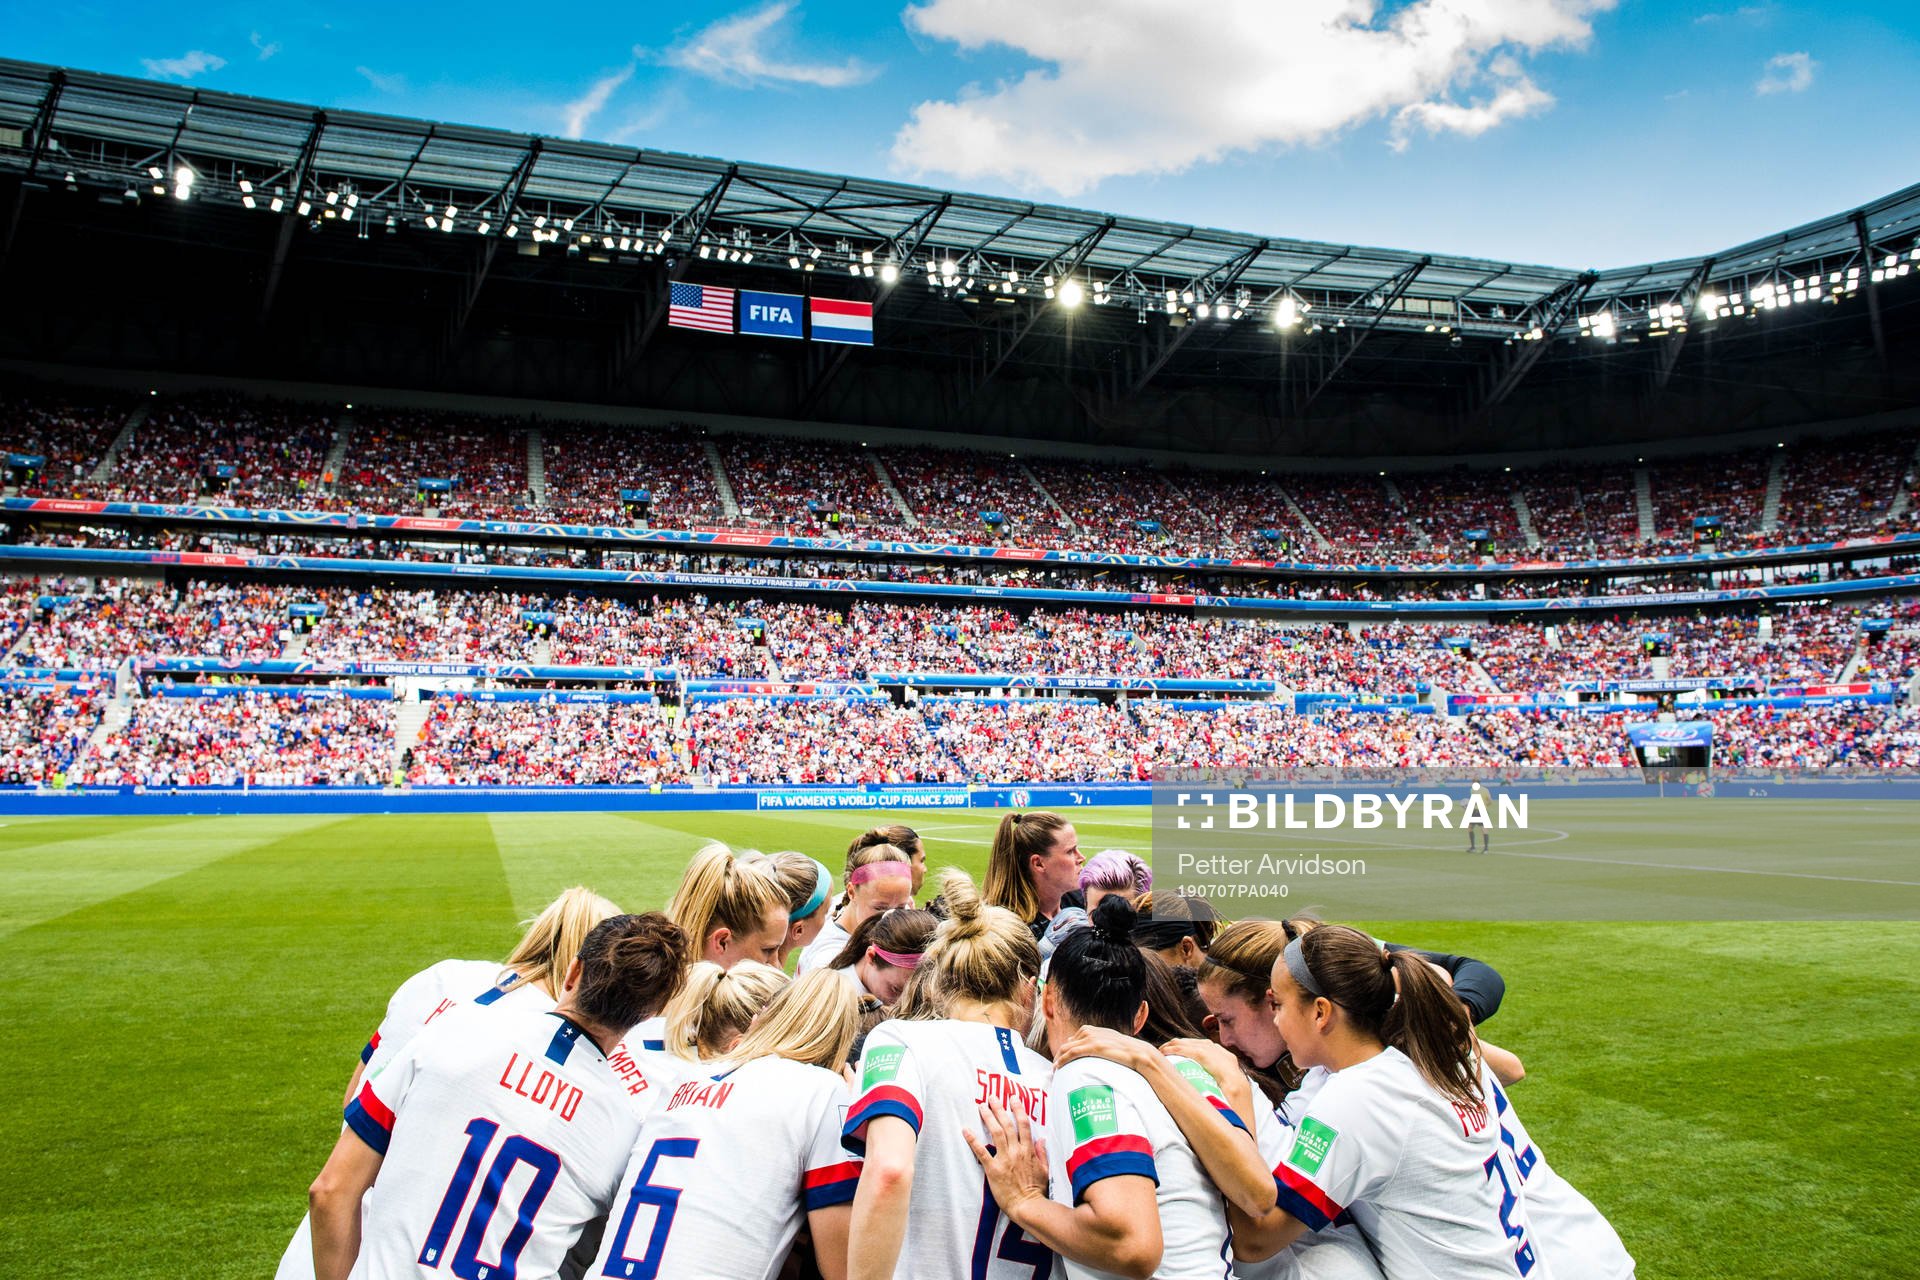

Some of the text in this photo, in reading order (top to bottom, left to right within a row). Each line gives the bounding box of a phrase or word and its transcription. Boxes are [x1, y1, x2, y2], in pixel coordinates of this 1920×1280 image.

[750, 305, 793, 324] FIFA
[203, 556, 226, 565] LYON
[362, 664, 469, 675] LE MOMENT DE BRILLER
[1078, 679, 1087, 687] TO
[202, 688, 218, 696] FIFA
[761, 796, 783, 807] FIFA
[786, 796, 836, 807] WOMEN'S
[838, 796, 876, 807] WORLD
[878, 795, 900, 806] CUP
[902, 794, 941, 805] FRANCE
[500, 1053, 584, 1122] LLOYD
[665, 1081, 734, 1111] BRIAN
[1072, 1097, 1112, 1111] LIVING
[1073, 1103, 1113, 1117] FOOTBALL
[1093, 1114, 1113, 1123] FIFA
[1303, 1148, 1322, 1164] FIFA
[417, 1117, 562, 1280] 10
[601, 1136, 701, 1280] 6
